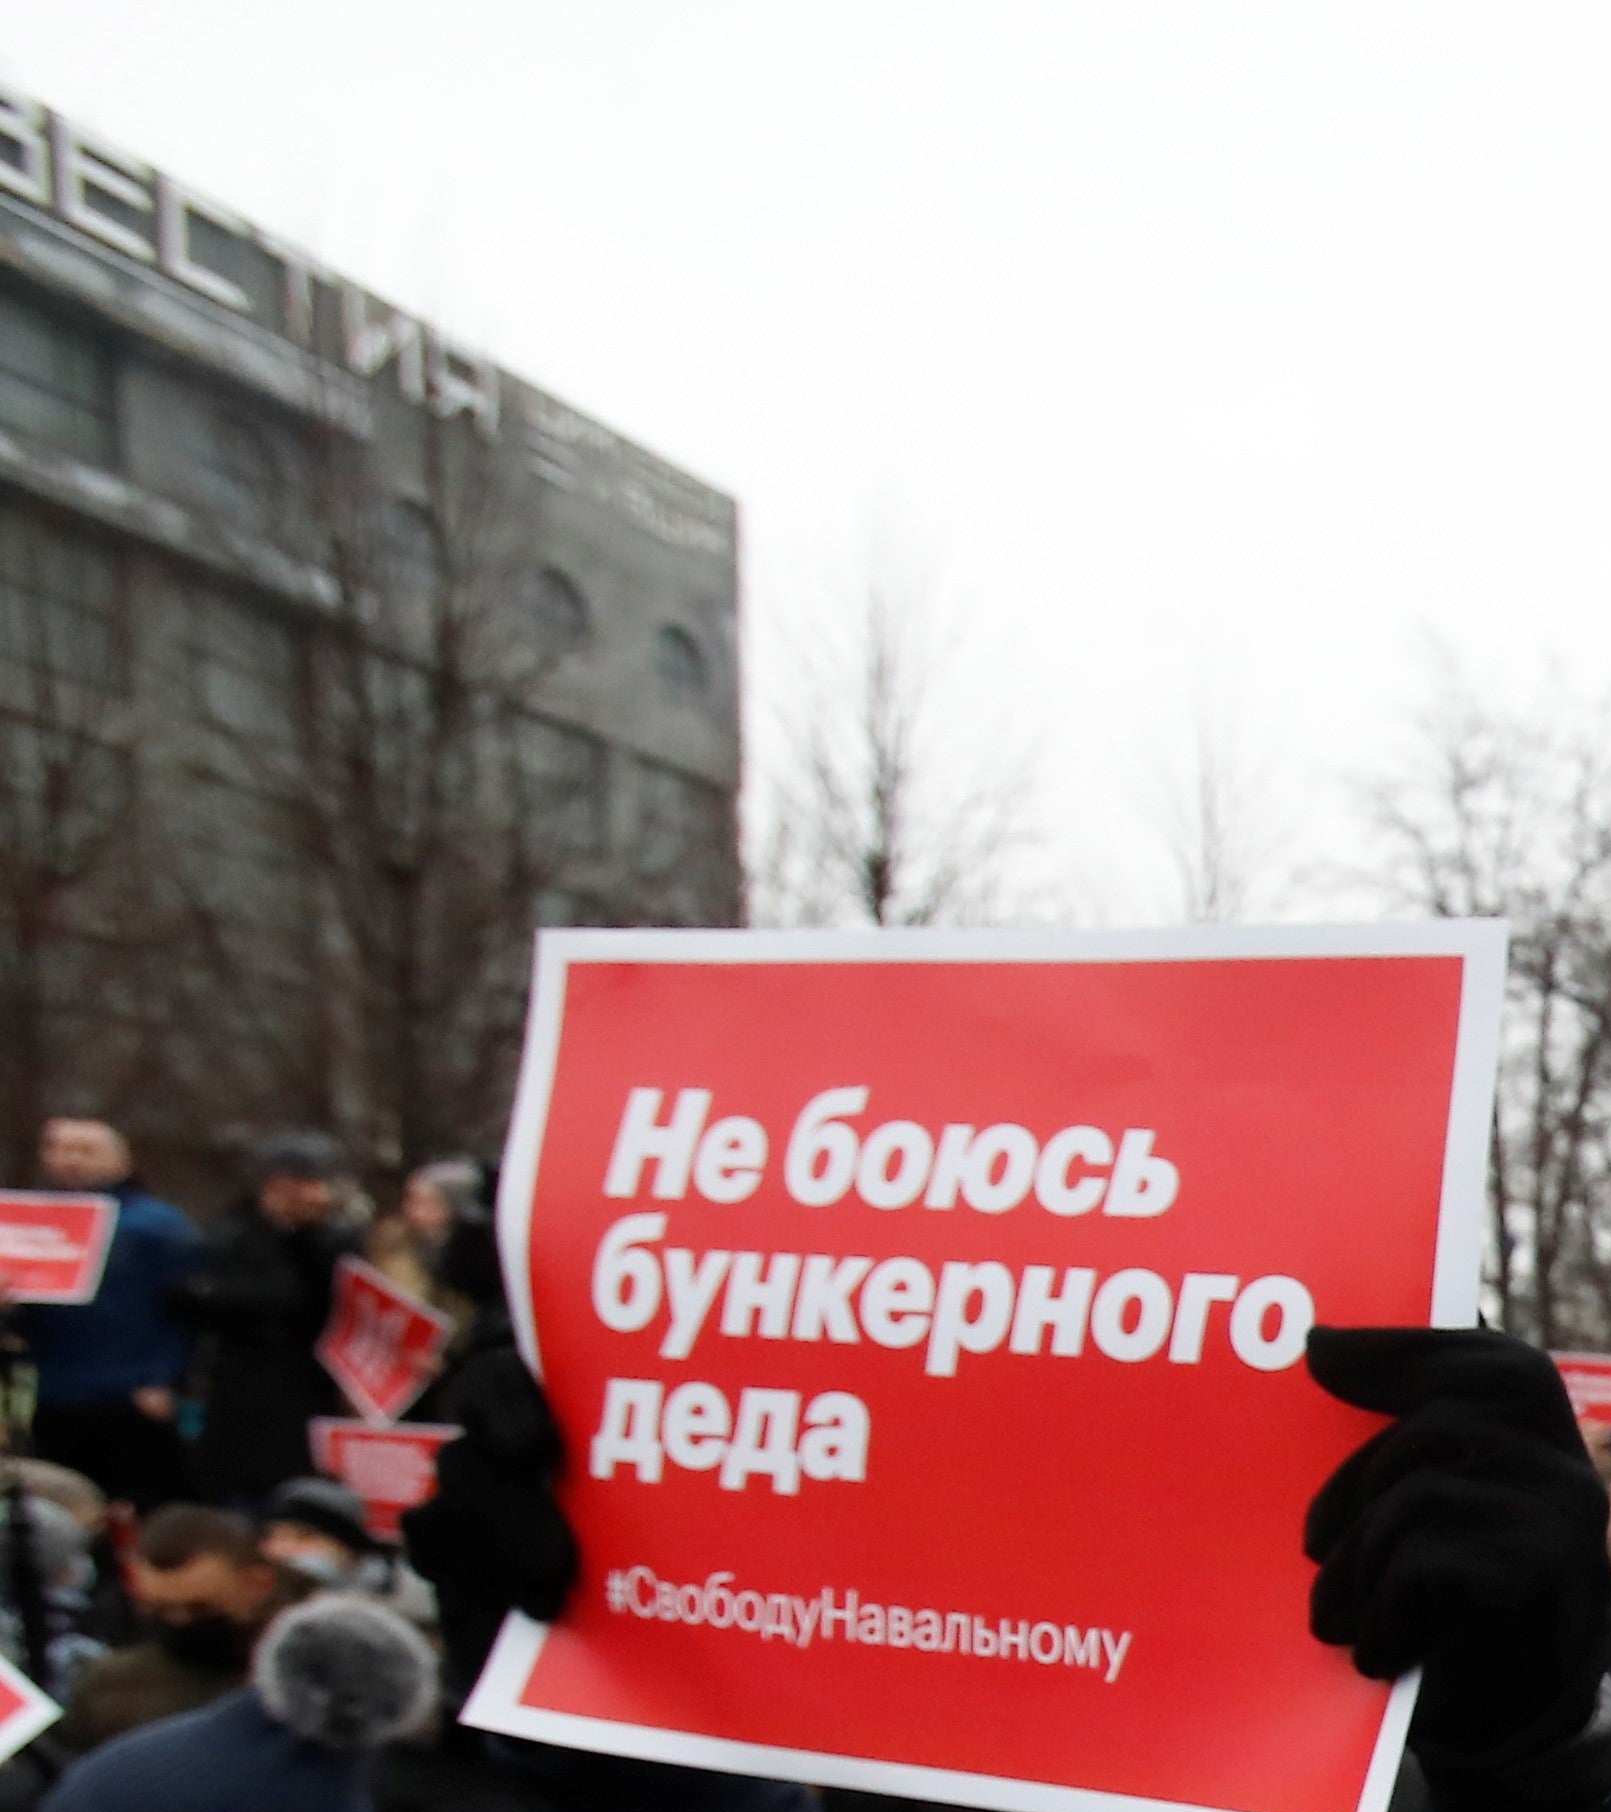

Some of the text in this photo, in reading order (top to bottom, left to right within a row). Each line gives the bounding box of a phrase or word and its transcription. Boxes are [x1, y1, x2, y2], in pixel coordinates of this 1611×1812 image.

[602, 1083, 1182, 1220] Не боюсь
[591, 1210, 1317, 1378] бункерного
[590, 1376, 872, 1496] деда
[605, 1566, 1133, 1684] #СвободуНавальному
